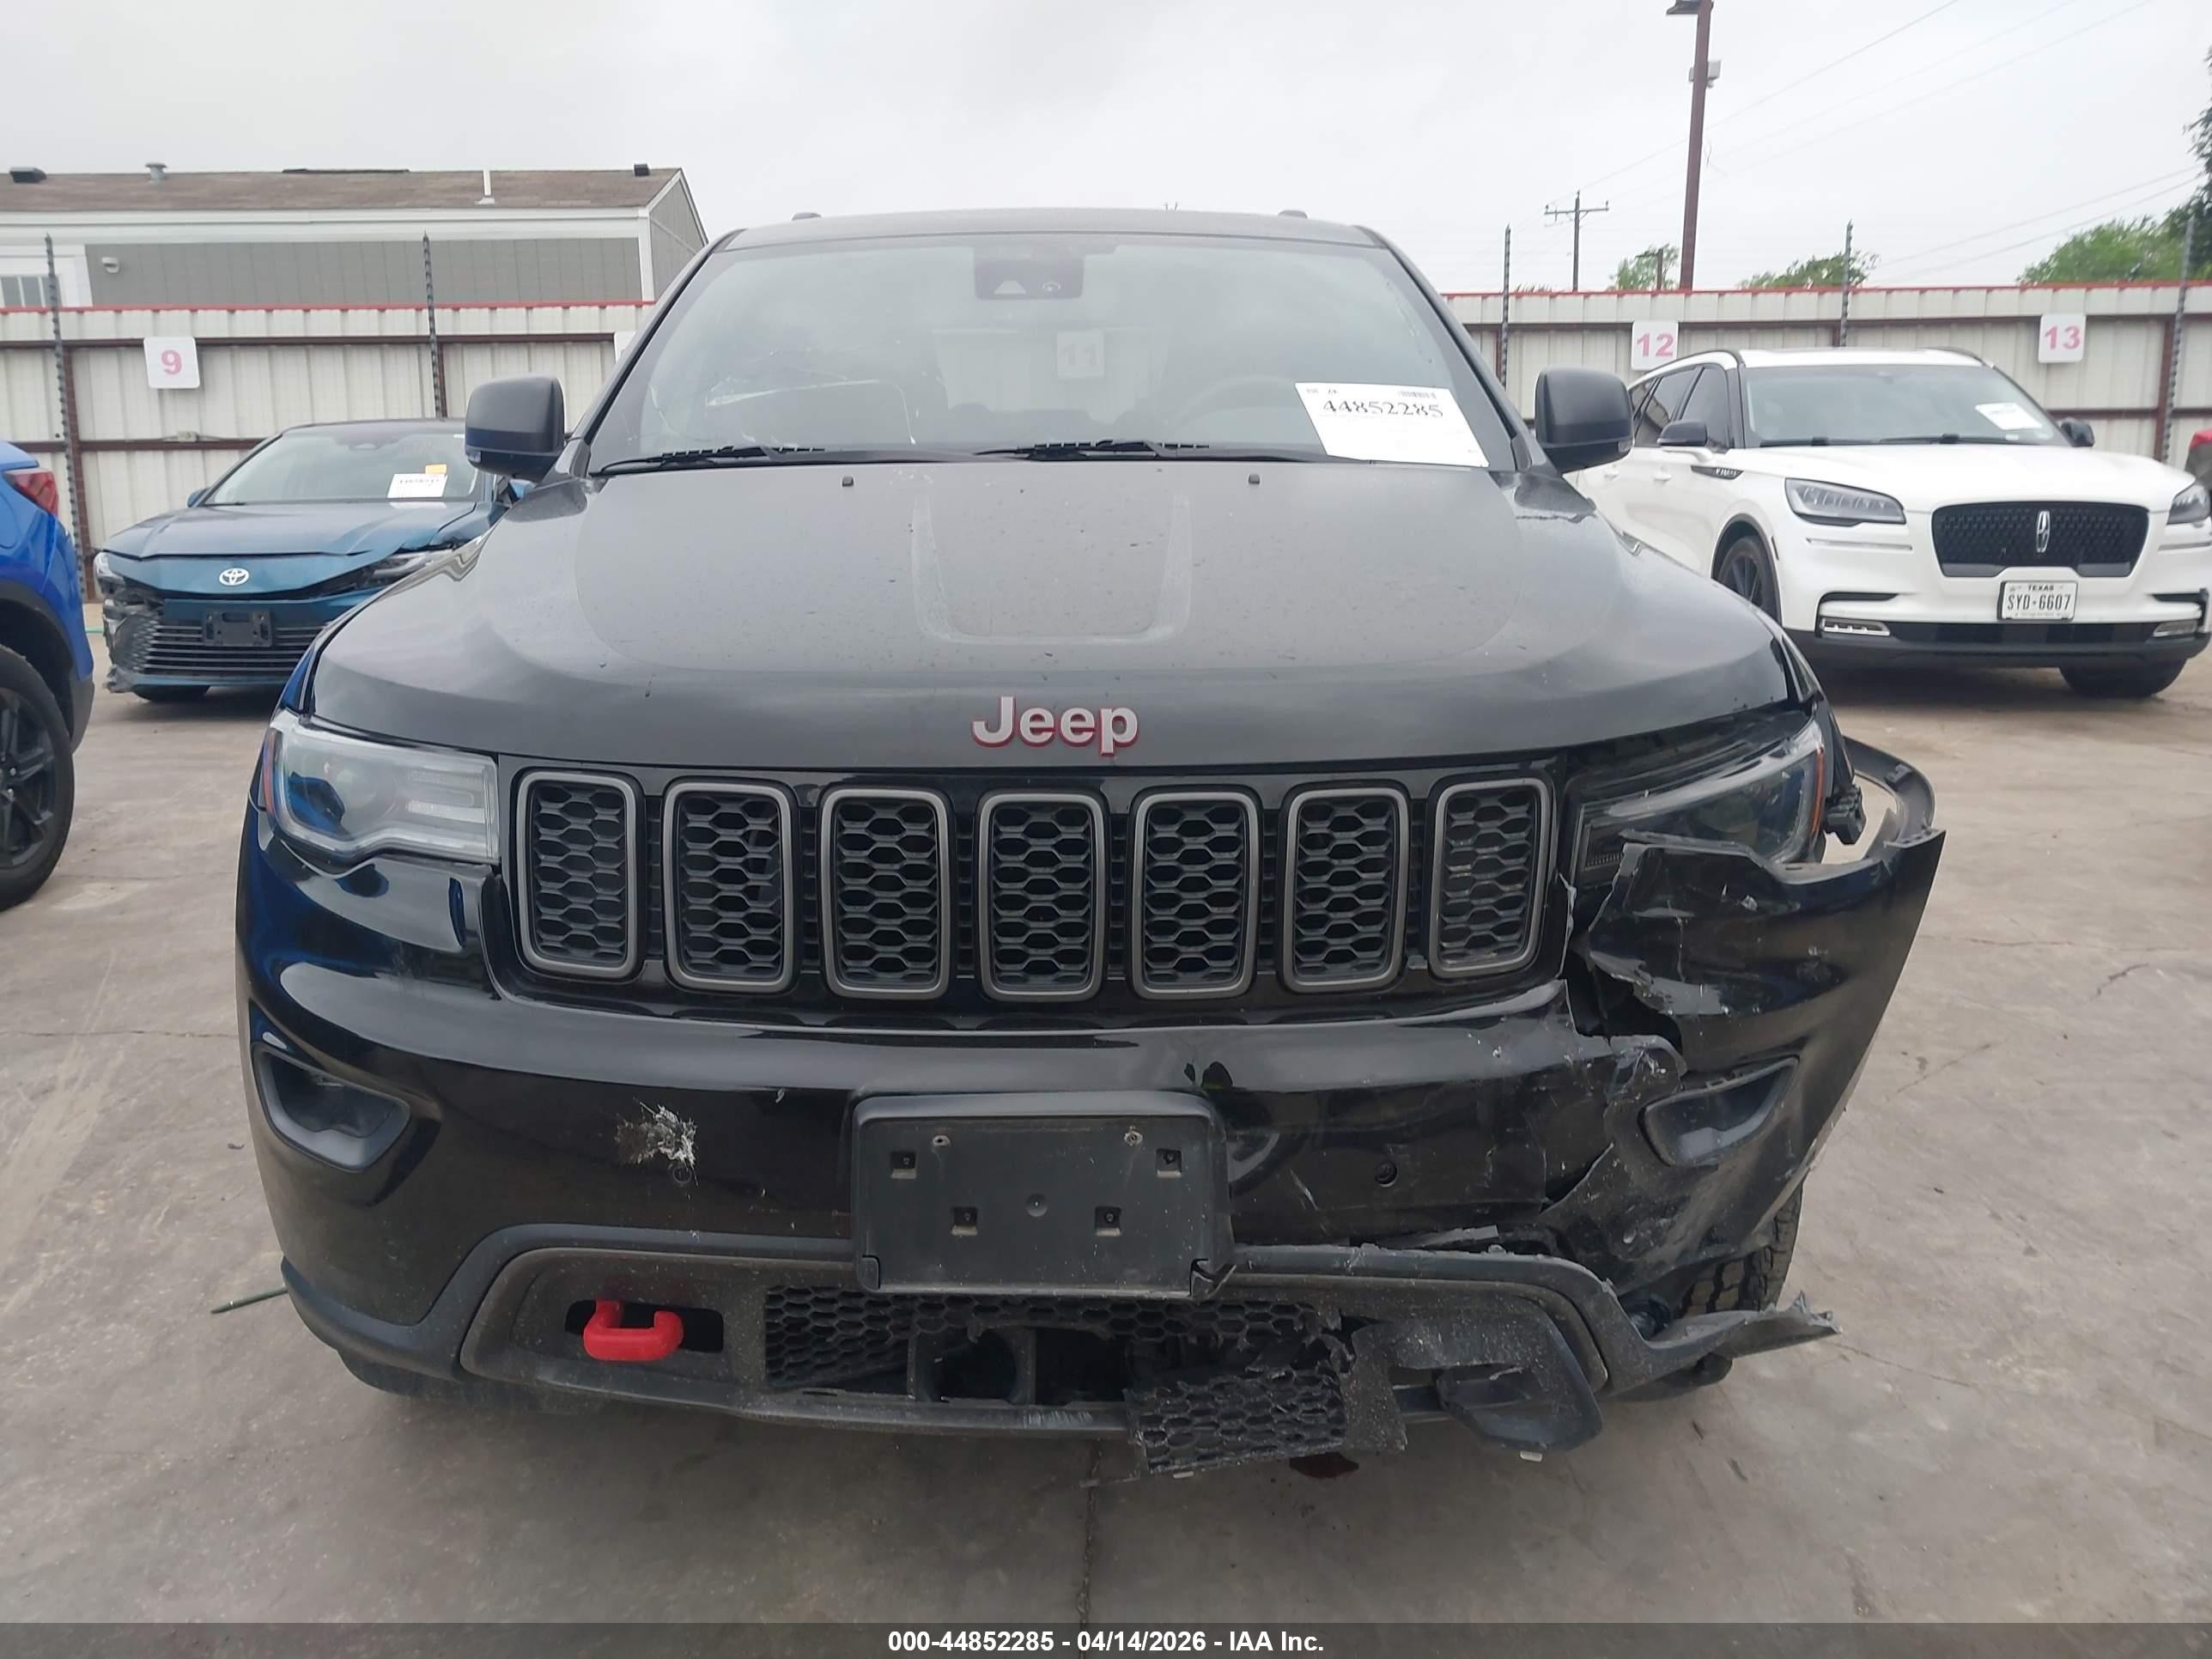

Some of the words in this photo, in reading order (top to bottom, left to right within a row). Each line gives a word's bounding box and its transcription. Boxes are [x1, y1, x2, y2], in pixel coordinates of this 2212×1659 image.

[1636, 332, 1674, 357] 12
[2045, 325, 2081, 349] 13
[161, 349, 182, 374] 9
[1061, 343, 1097, 366] 11
[1323, 399, 1443, 418] 44852285
[971, 695, 1140, 757] Jeep
